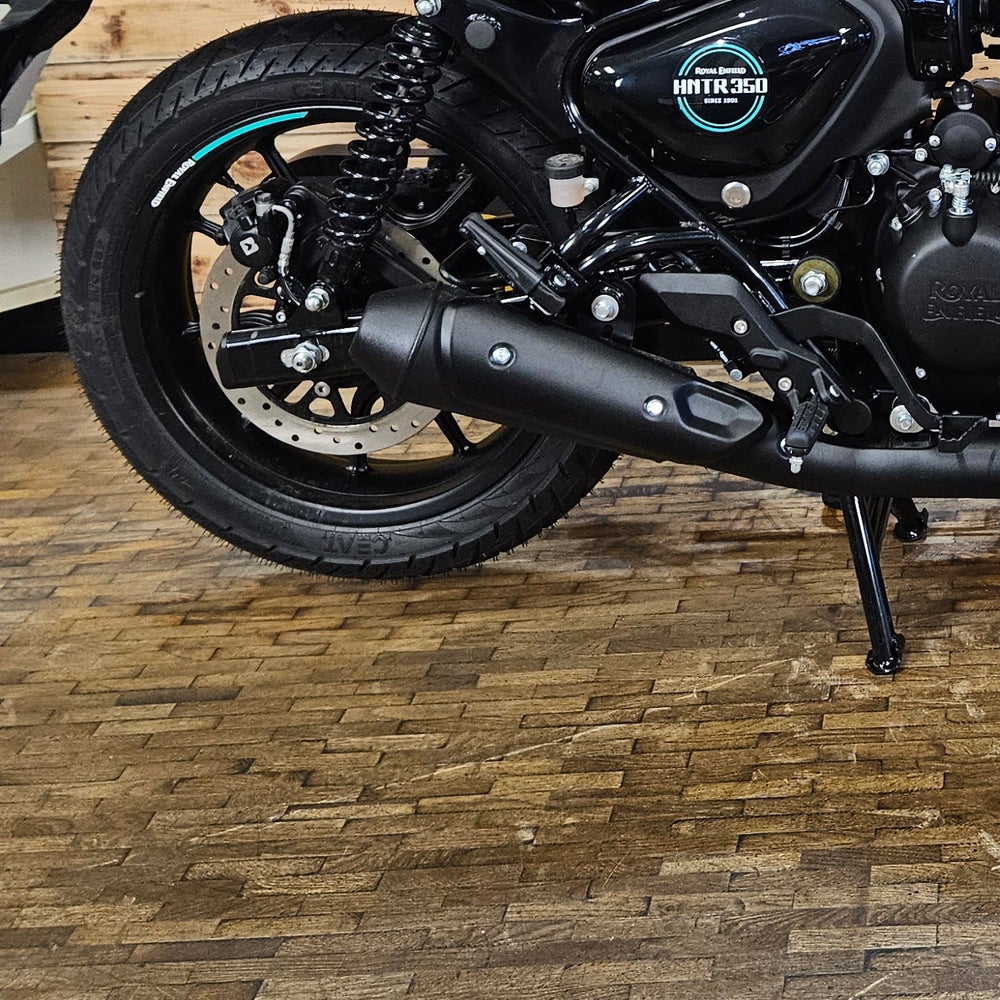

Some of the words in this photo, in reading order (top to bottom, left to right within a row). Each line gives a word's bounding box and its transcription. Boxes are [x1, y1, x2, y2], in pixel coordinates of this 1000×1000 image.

[695, 66, 717, 75] ROYAL
[718, 66, 747, 75] ENFIELD
[673, 78, 729, 95] HNTR
[730, 77, 768, 94] 350
